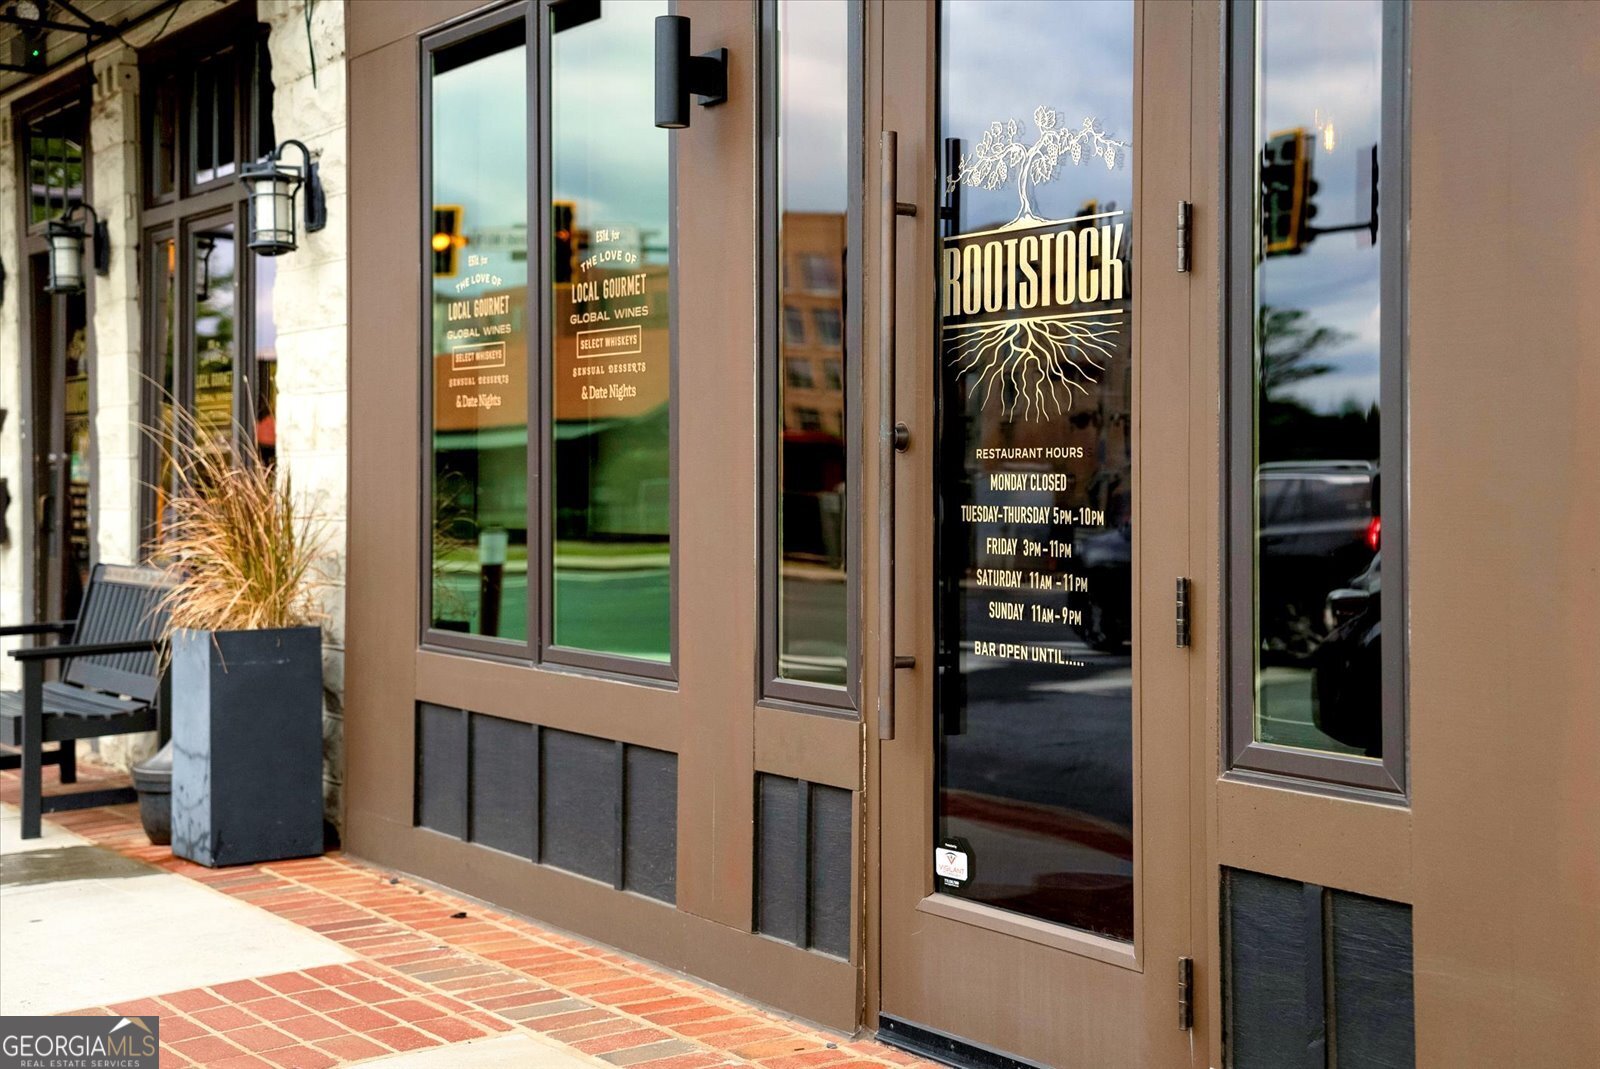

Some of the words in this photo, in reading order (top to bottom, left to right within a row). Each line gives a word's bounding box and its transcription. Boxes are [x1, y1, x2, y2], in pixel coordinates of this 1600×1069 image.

[580, 255, 598, 272] THE
[600, 250, 622, 262] LOVE
[624, 252, 637, 264] OF
[943, 223, 1123, 317] ROOTSTOCK
[456, 277, 470, 293] THE
[471, 273, 491, 285] LOVE
[491, 275, 503, 287] OF
[571, 281, 600, 304] LOCAL
[602, 273, 647, 299] GOURMET
[448, 300, 471, 321] LOCAL
[474, 295, 510, 317] GOURMET
[569, 311, 611, 325] GLOBAL
[614, 305, 649, 319] WINES
[447, 327, 480, 340] GLOBAL
[483, 323, 512, 336] WINES
[580, 338, 604, 350] SELECT
[605, 334, 638, 347] WHISKEYS
[455, 352, 475, 363] SELECT
[475, 349, 503, 361] WHISKEYS
[572, 365, 605, 378] SENSUAL
[608, 361, 647, 374] DESSERTS
[581, 385, 588, 400] &
[588, 385, 608, 400] Date
[608, 383, 637, 401] Nights
[462, 394, 478, 408] Date
[478, 393, 502, 410] Nights
[976, 448, 1043, 459] RESTAURANT
[1045, 447, 1083, 458] HOURS
[990, 474, 1027, 491] MONDAY
[1030, 473, 1067, 492] CLOSED
[987, 537, 1017, 555] FRIDAY
[976, 568, 1022, 588] SATURDAY
[989, 602, 1024, 620] SUNDAY
[974, 641, 996, 656] BAR
[999, 644, 1028, 661] OPEN
